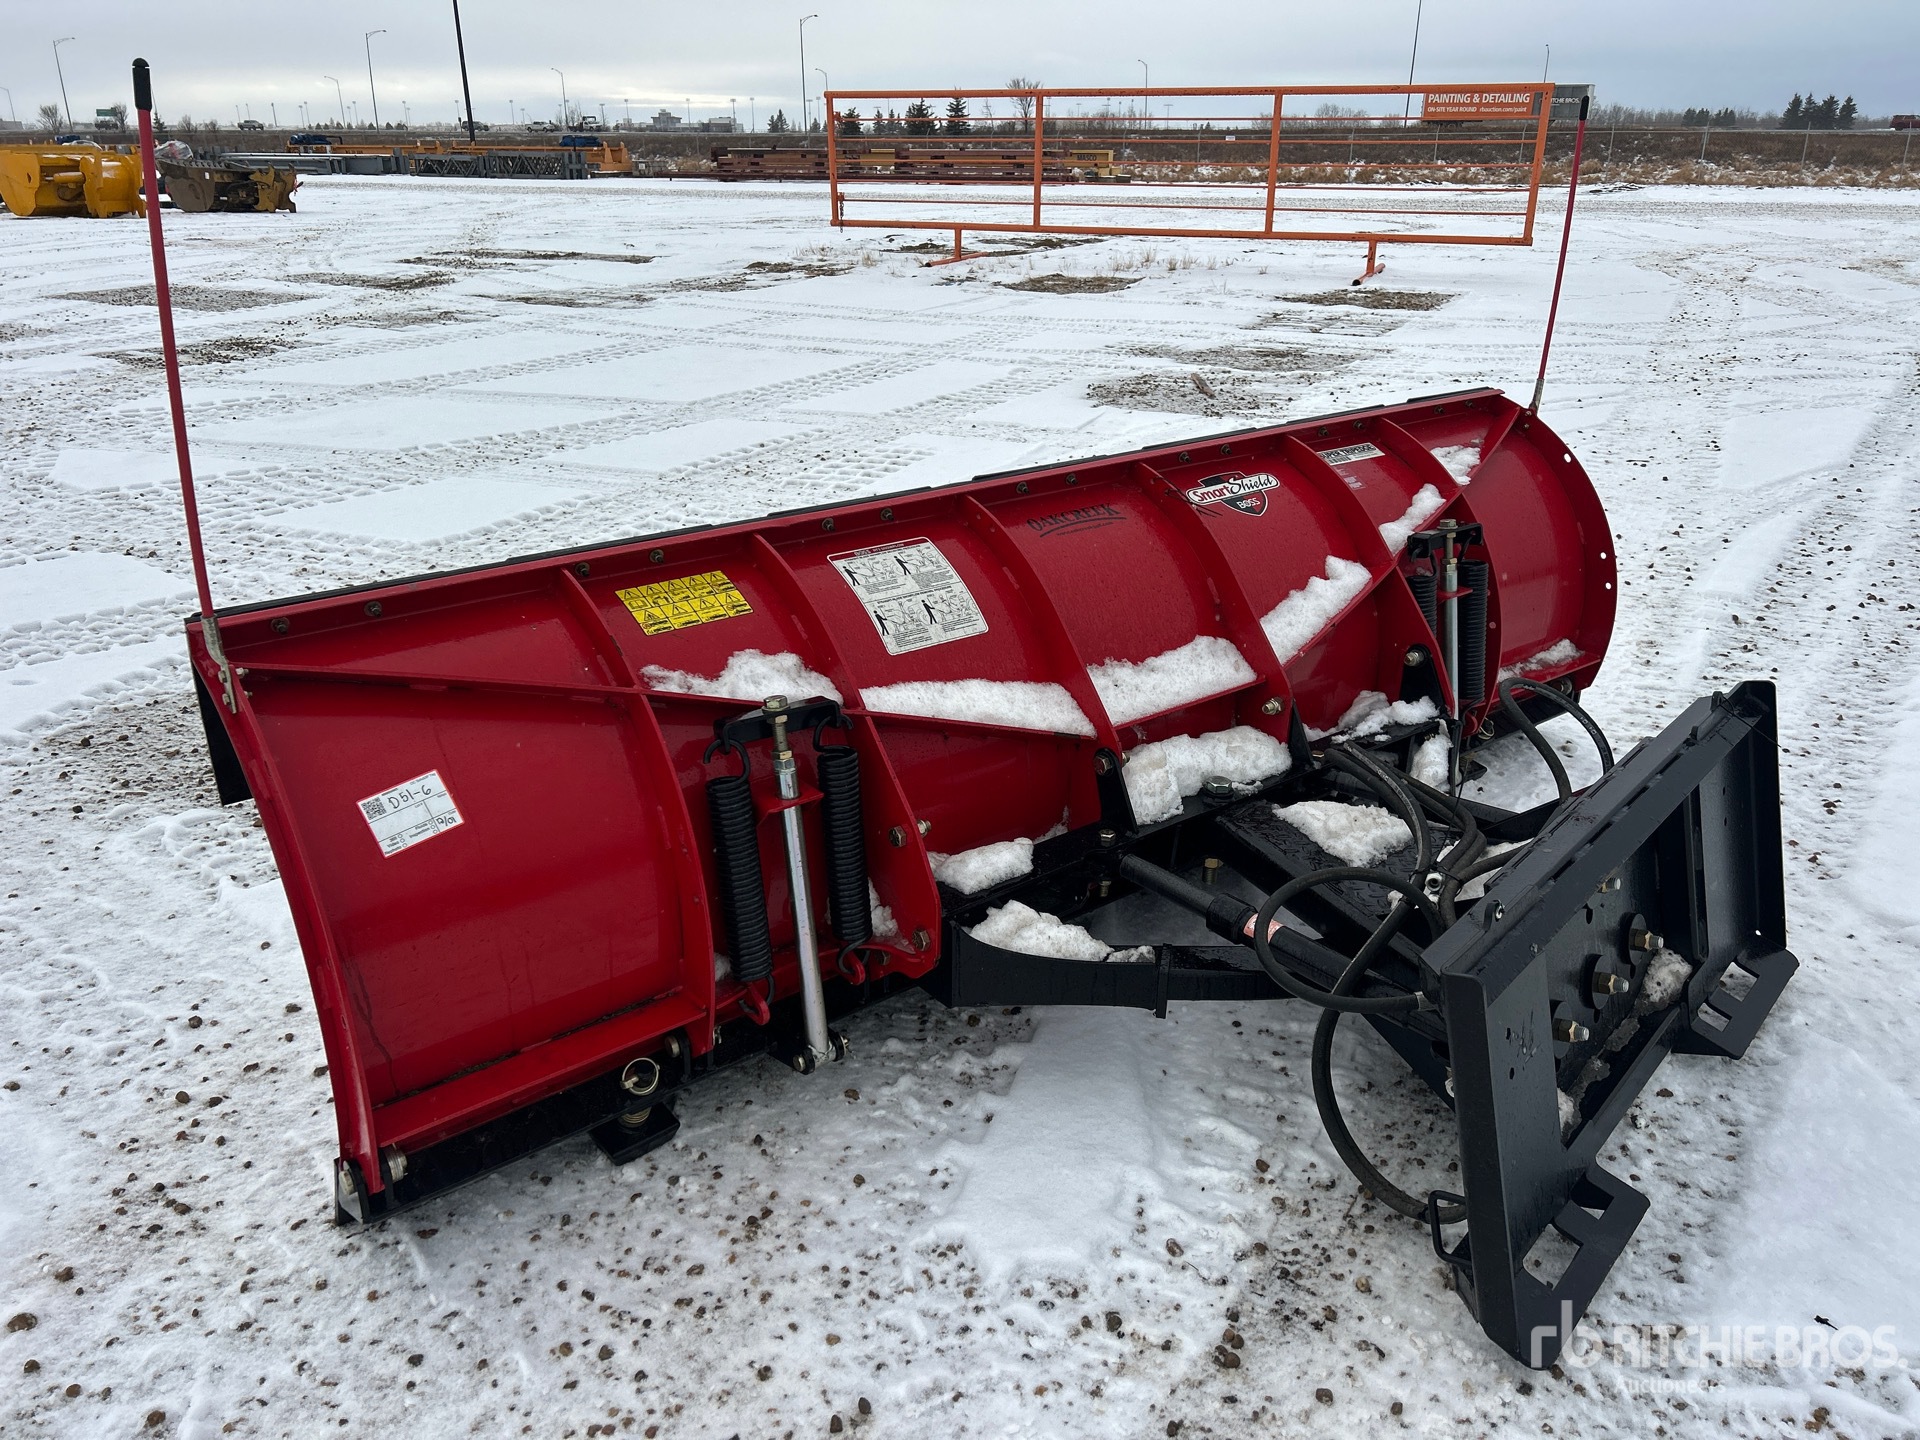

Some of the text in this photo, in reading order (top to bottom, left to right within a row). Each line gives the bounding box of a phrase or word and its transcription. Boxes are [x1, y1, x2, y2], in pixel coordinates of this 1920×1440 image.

[1428, 93, 1530, 103] PAINTING & DETAILING
[1479, 106, 1527, 114] rbauction.com/paint
[1236, 497, 1261, 509] BOSS
[1026, 503, 1120, 532] OAKCREEK
